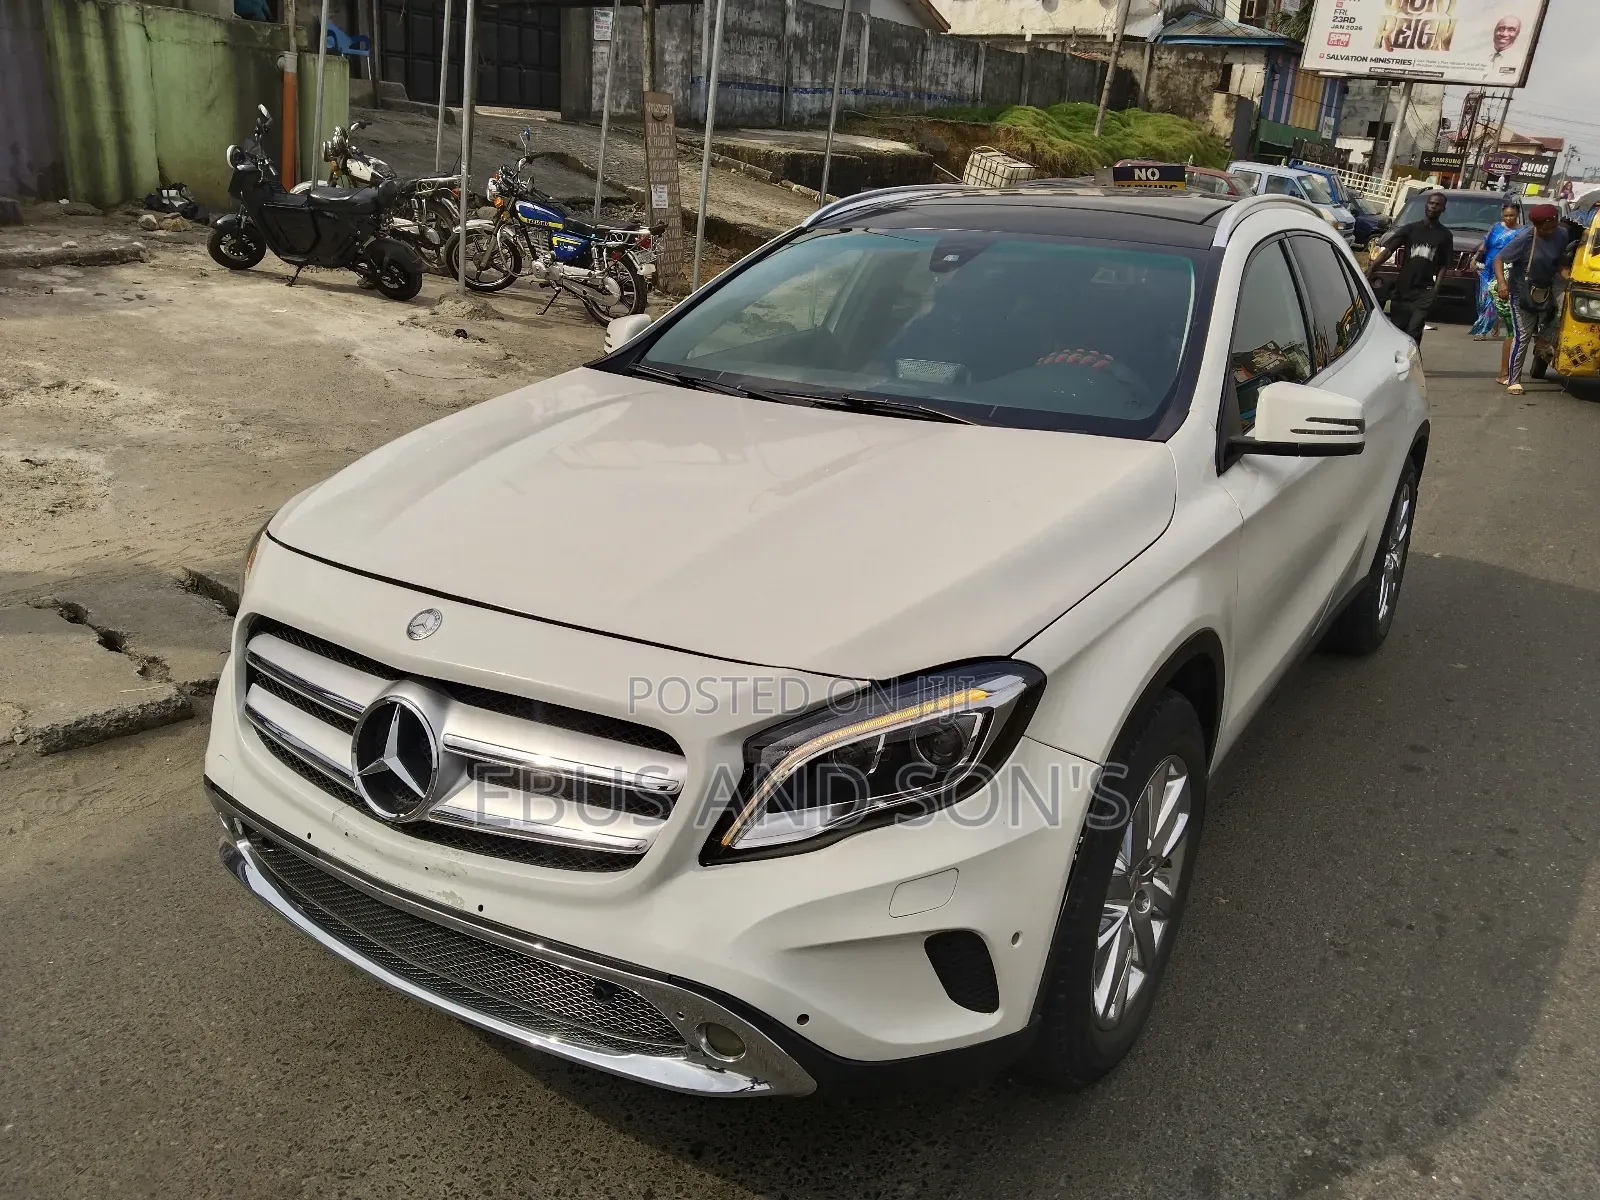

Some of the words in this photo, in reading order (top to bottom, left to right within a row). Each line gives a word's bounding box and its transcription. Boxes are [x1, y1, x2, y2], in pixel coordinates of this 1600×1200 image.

[1332, 15, 1356, 24] 23RD
[1372, 15, 1459, 52] REIGN
[1325, 53, 1369, 63] SALVATION
[1369, 56, 1413, 66] MINISTRIES
[1431, 156, 1462, 165] SAMSUNG
[1133, 167, 1160, 181] NO
[1520, 161, 1549, 174] SUNG
